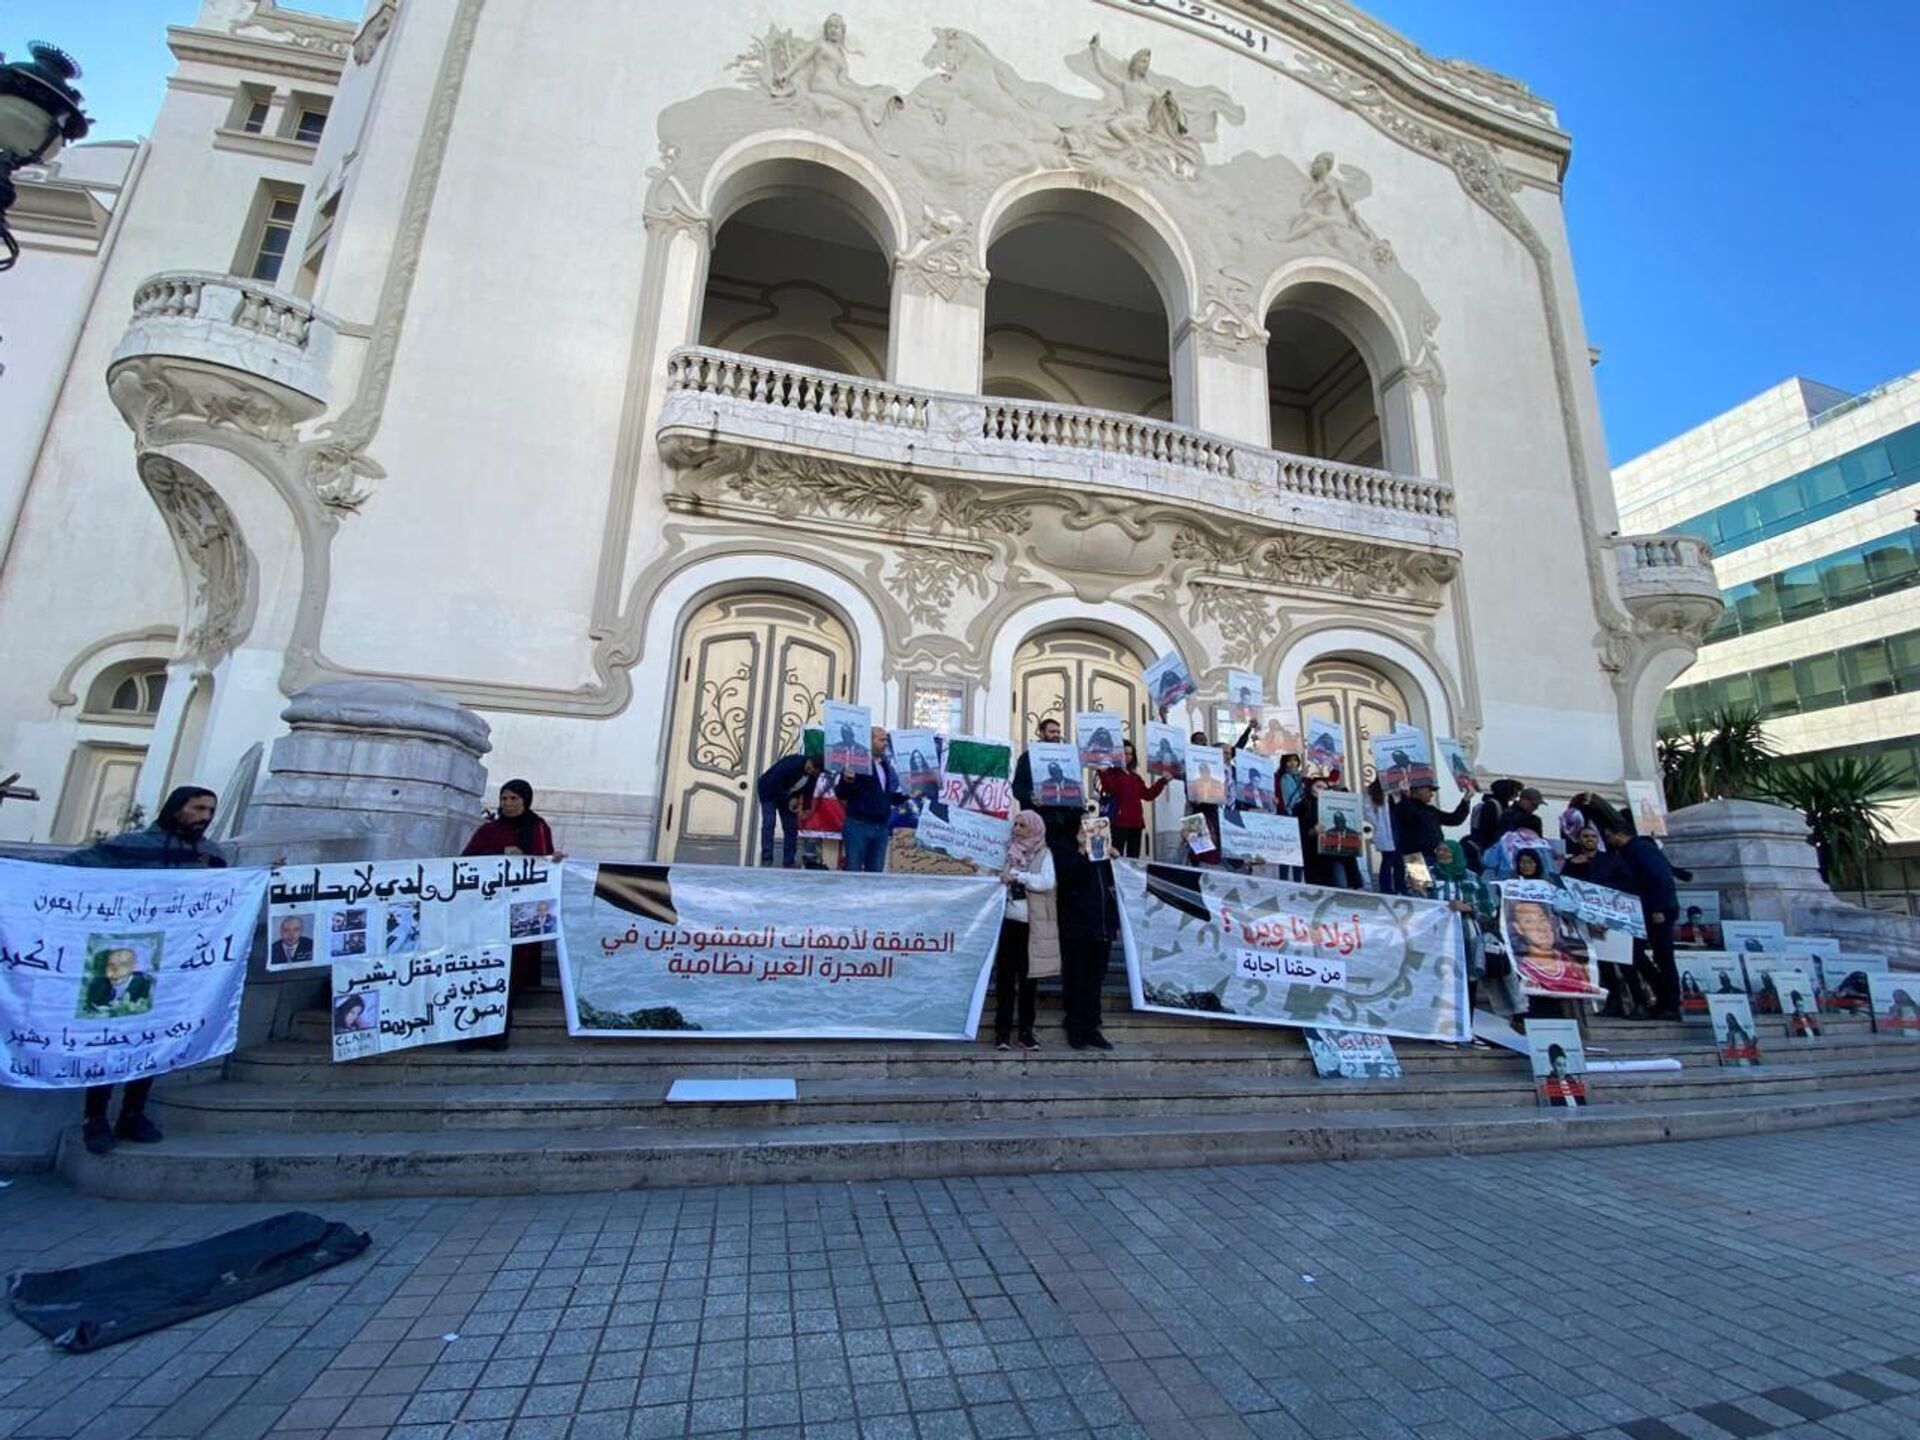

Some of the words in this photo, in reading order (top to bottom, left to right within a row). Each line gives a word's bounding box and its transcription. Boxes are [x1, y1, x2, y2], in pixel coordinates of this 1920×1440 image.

[375, 864, 437, 902] ولدي
[437, 861, 479, 902] قتل
[482, 858, 548, 900] طلياني
[180, 933, 236, 970] الله
[601, 923, 639, 956] في
[645, 926, 776, 952] المفقودين
[782, 926, 867, 950] لأمهات
[873, 931, 955, 956] الحقيقة
[338, 961, 397, 993] بشير
[399, 958, 442, 986] مقتل
[668, 952, 754, 979] نظامية
[756, 955, 814, 982] الغير
[819, 955, 893, 983] الهجرة
[1243, 952, 1280, 977] اجابة
[1284, 958, 1317, 978] حقنا
[1321, 967, 1341, 983] من
[433, 983, 458, 1011] في
[380, 1002, 434, 1040] الجريمة
[62, 1027, 76, 1051] يا
